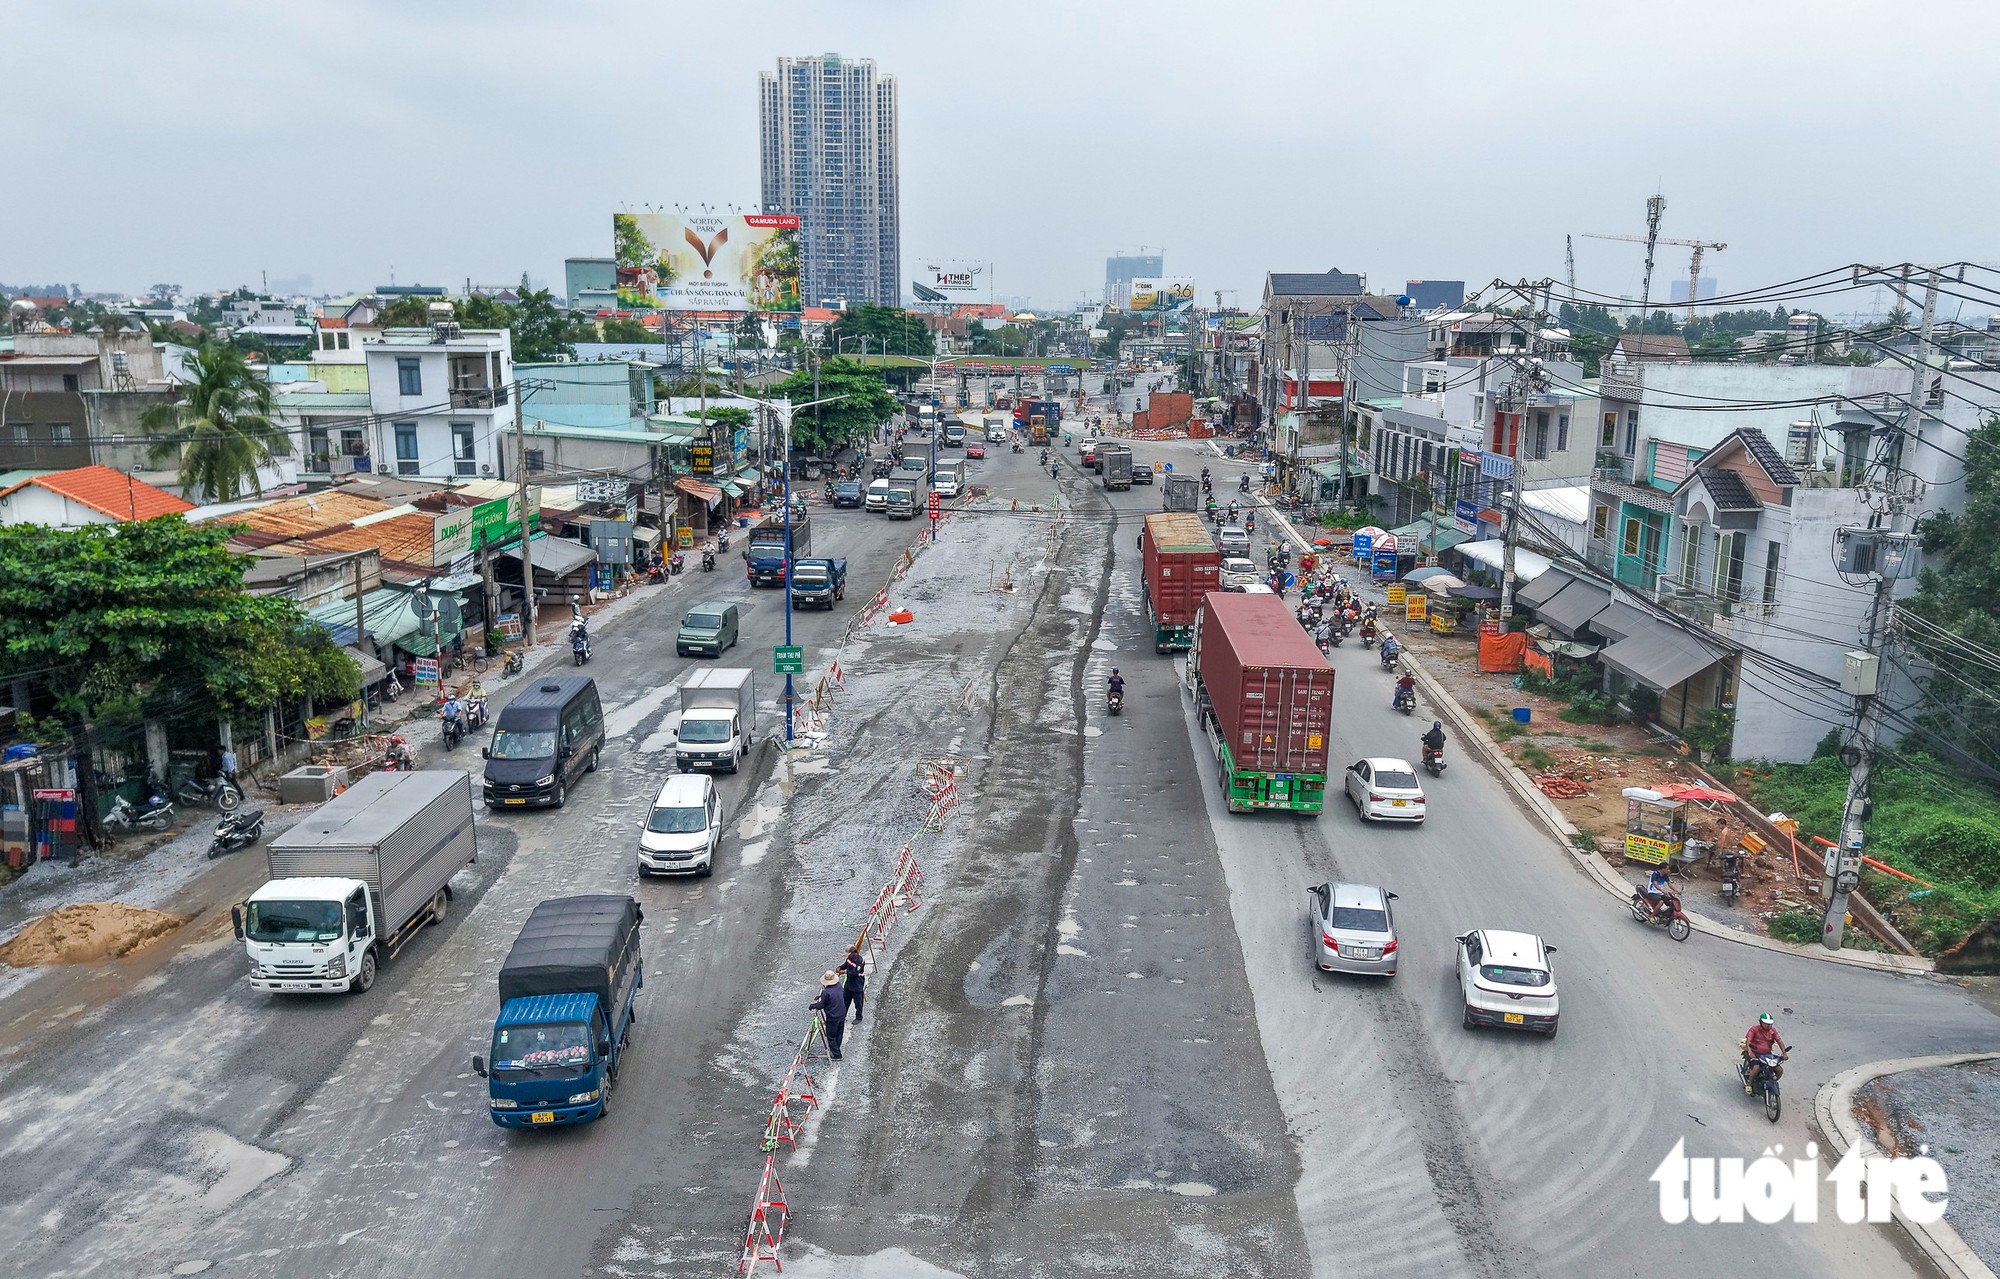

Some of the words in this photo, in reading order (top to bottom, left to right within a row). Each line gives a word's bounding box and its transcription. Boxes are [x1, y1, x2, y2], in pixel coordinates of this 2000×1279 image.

[689, 217, 723, 225] NORTON
[696, 225, 716, 233] PARK
[949, 272, 970, 281] THÉP
[670, 288, 694, 296] CHUẨN
[695, 288, 714, 297] SỐNG
[714, 289, 733, 297] TOÀN
[734, 289, 747, 297] CẦU
[692, 447, 712, 456] PHỤNG
[695, 456, 711, 466] PHÁT
